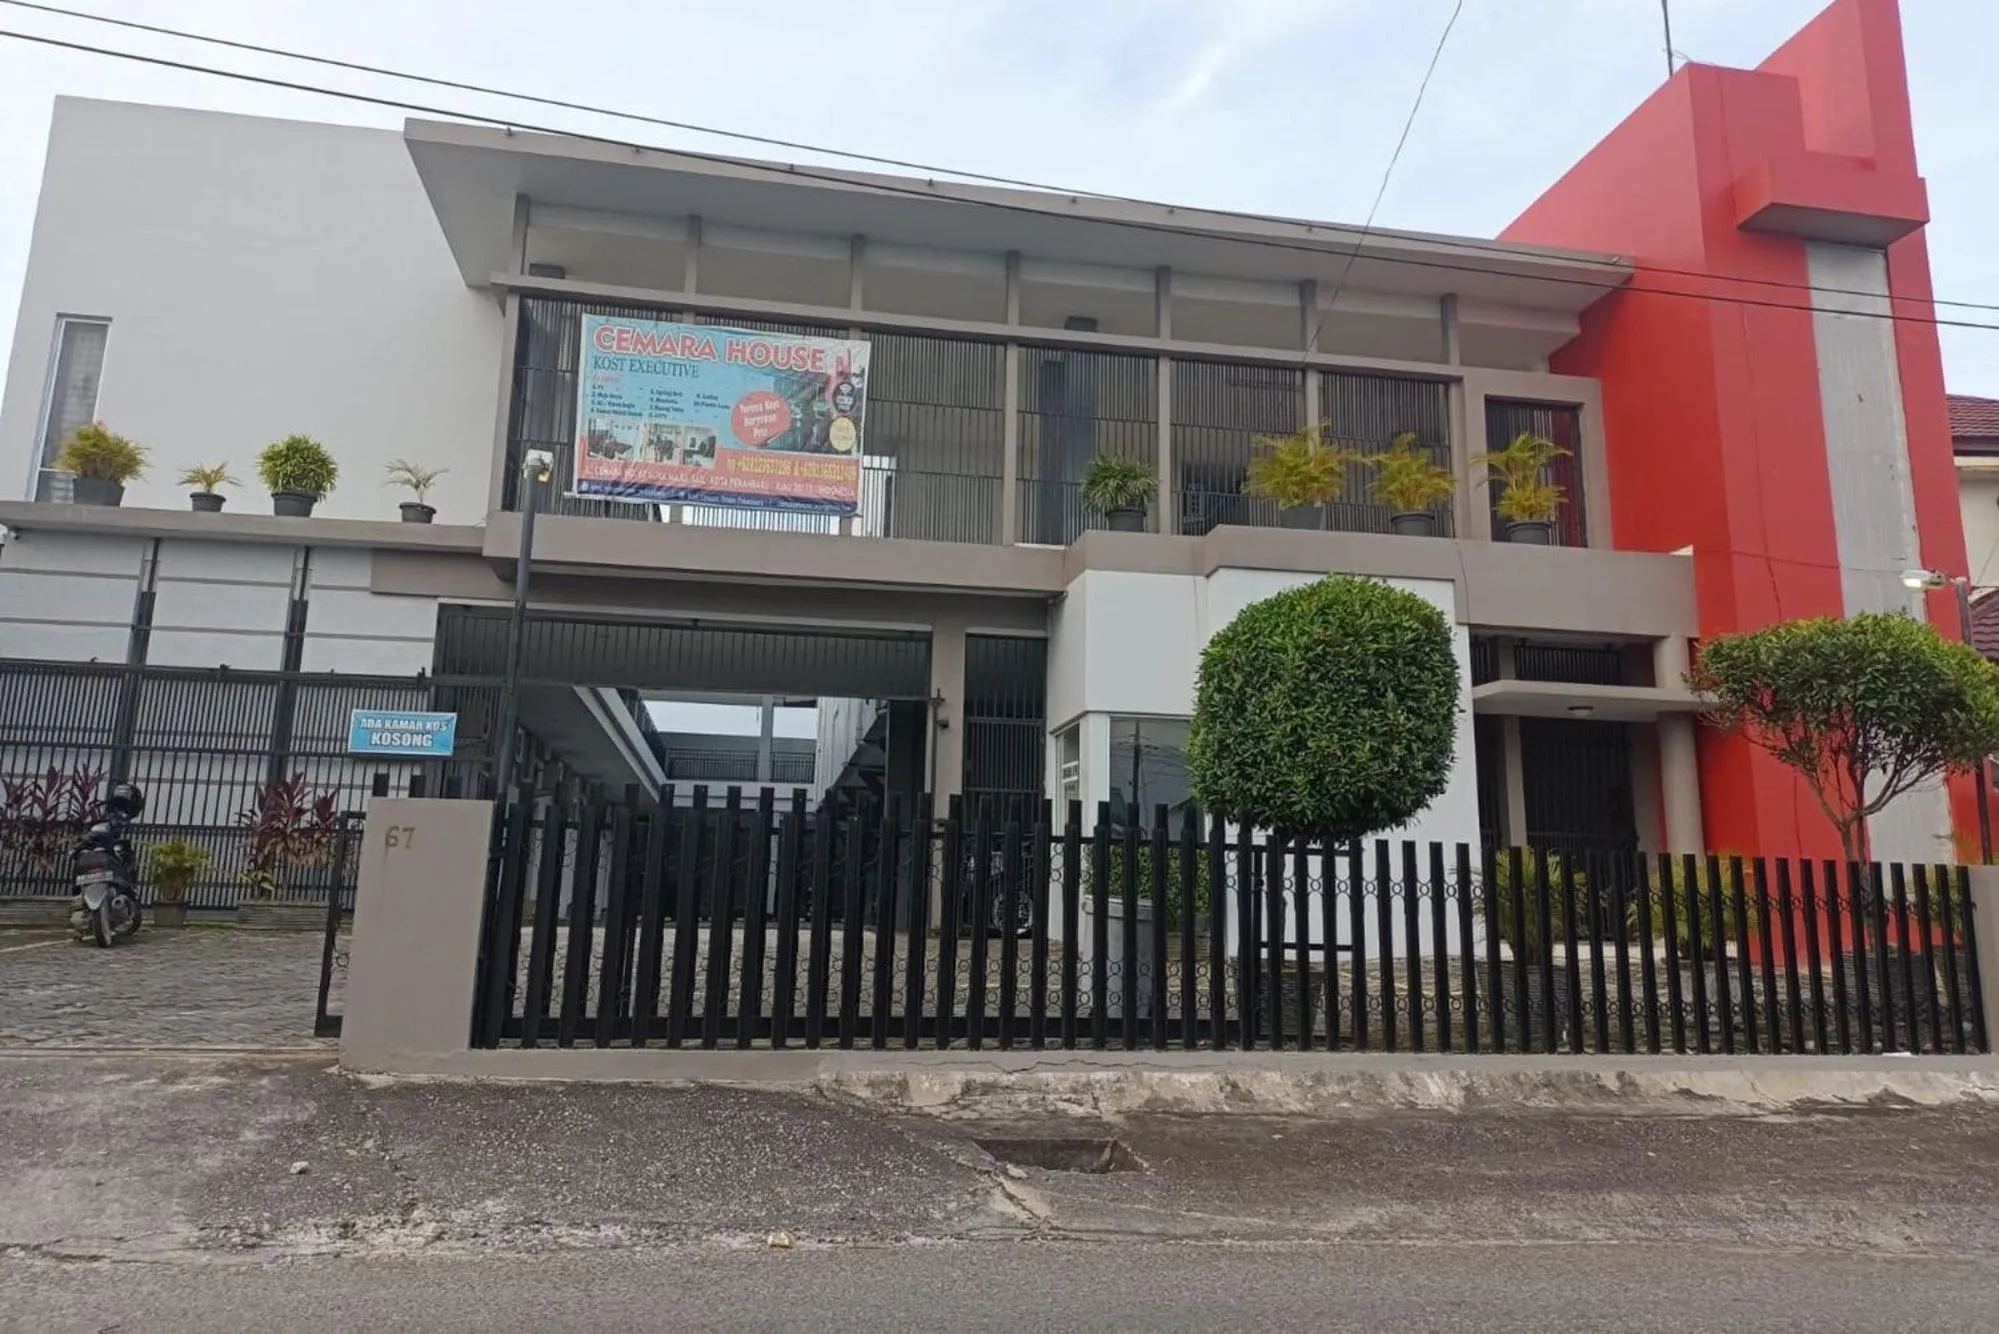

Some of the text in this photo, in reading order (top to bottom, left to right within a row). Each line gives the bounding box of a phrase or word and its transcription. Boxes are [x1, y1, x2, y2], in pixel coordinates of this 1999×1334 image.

[593, 325, 826, 373] CEMARA HOUSE
[592, 355, 627, 372] KOST
[629, 359, 700, 379] EXECUTIVE
[361, 717, 448, 732] ADA KAMAR KOS
[371, 731, 434, 748] KOSONG
[384, 825, 416, 850] 67
